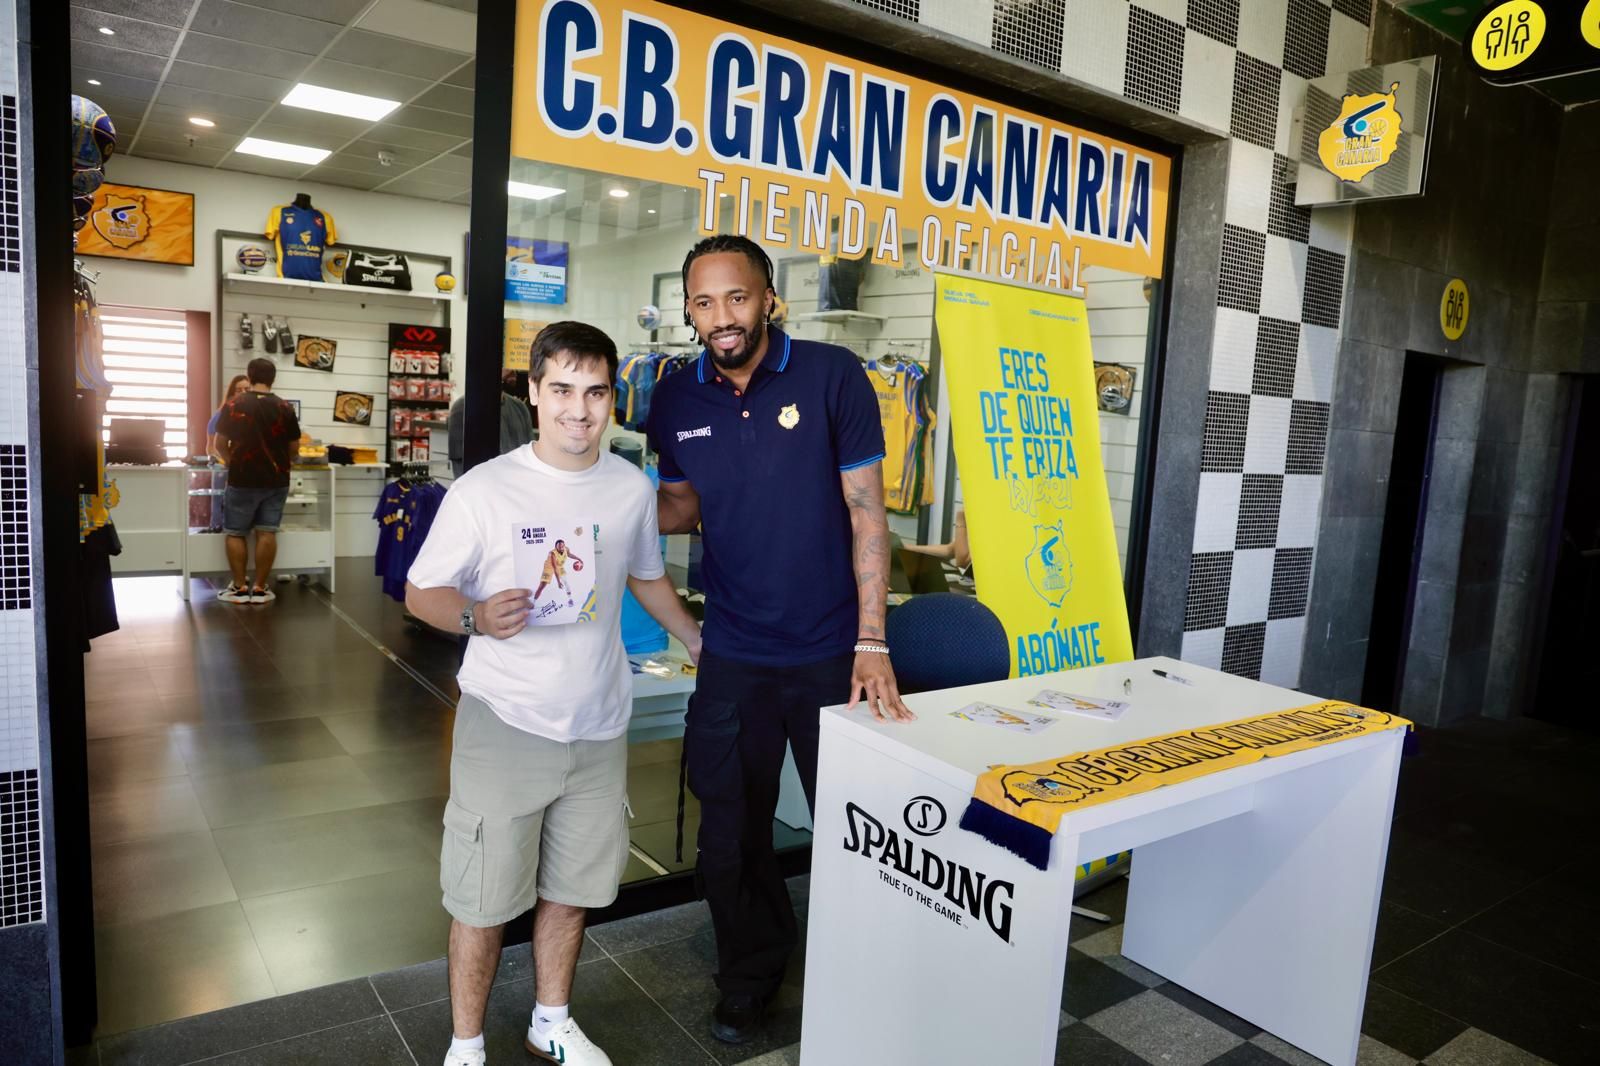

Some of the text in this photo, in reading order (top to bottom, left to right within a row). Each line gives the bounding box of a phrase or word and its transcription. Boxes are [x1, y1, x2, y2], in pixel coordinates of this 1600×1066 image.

[706, 33, 908, 198] GRAN
[922, 93, 1153, 253] CANARIA
[1337, 147, 1381, 167] CANARIA
[1345, 136, 1372, 151] GRAN
[699, 169, 1085, 293] TIENDA OFICIAL
[362, 273, 395, 284] SPALDING
[998, 346, 1049, 393] ERES
[676, 425, 712, 442] SPALDING
[979, 391, 1073, 437] DE QUIEN
[985, 436, 1079, 480] TE ERIZA
[521, 528, 531, 539] 24
[1017, 617, 1105, 678] ABÓNATE
[843, 801, 1015, 944] SPALDING
[878, 869, 962, 926] TRUE TO THE GAME
